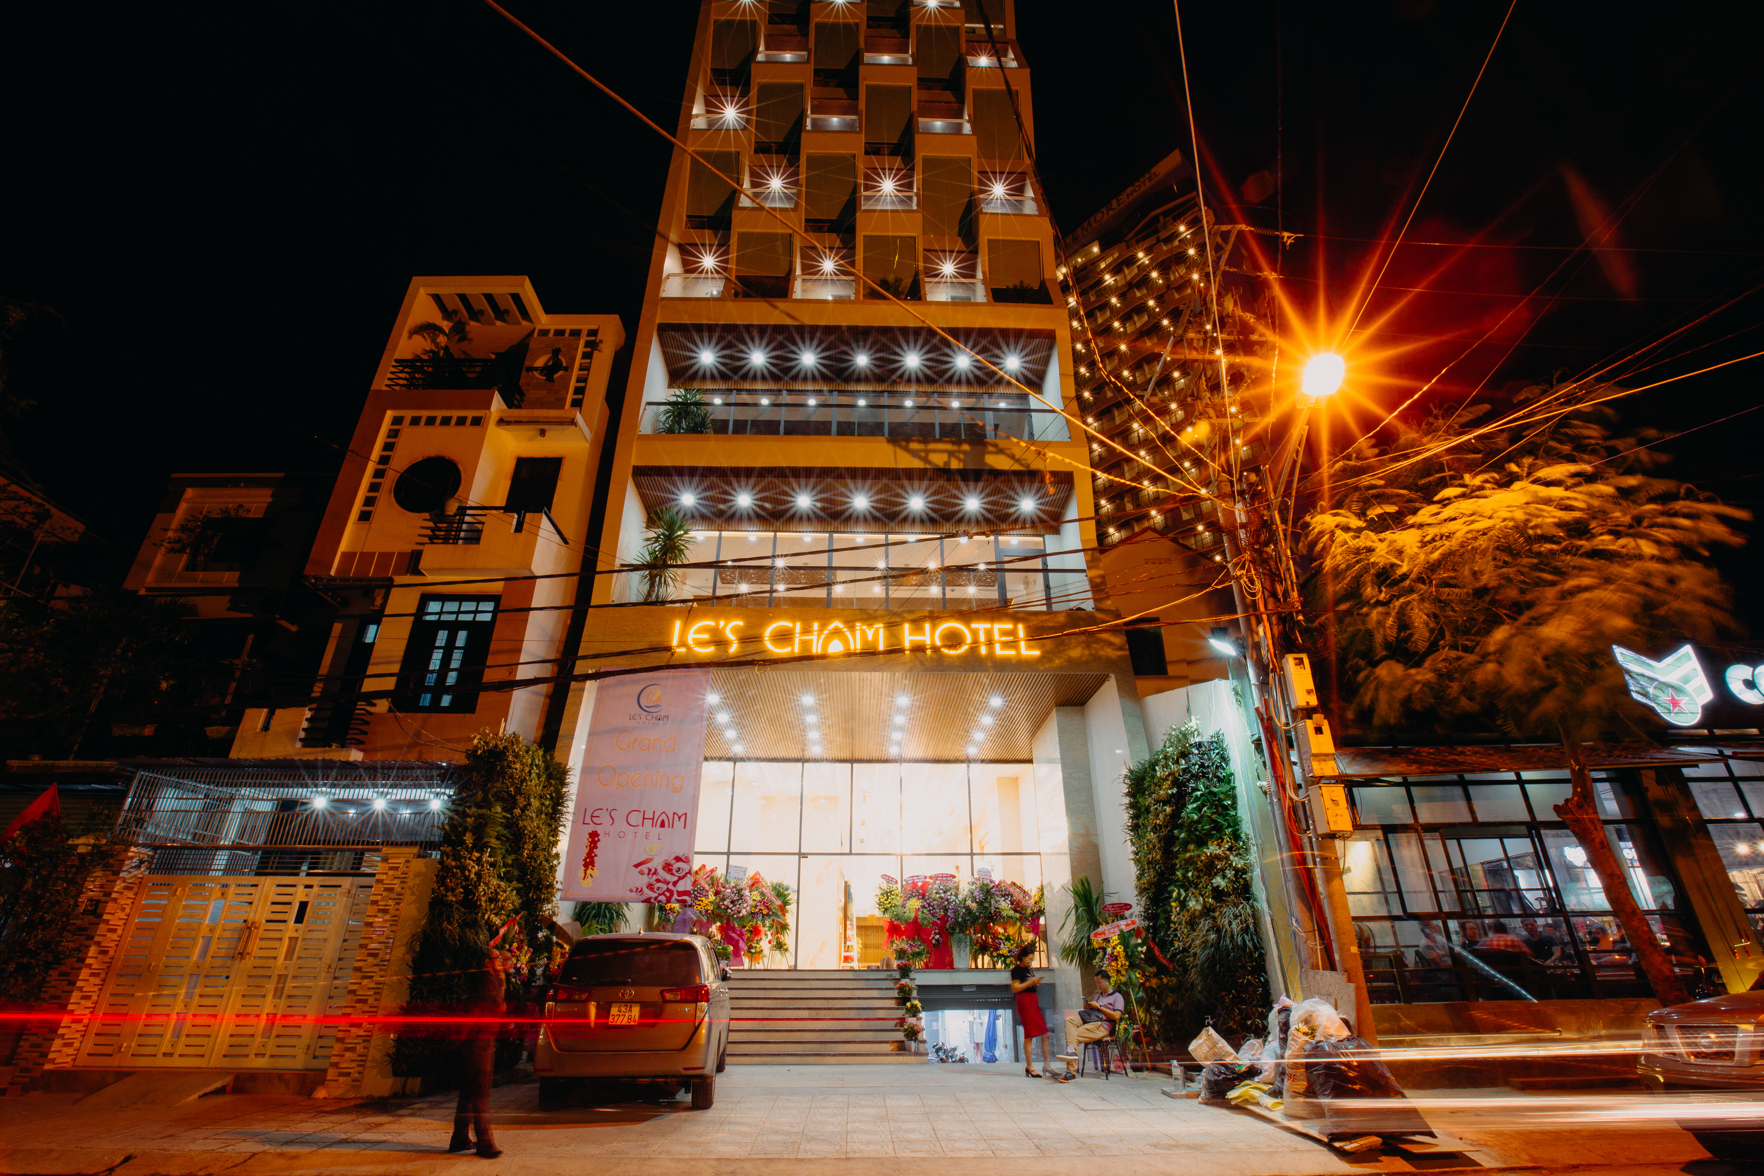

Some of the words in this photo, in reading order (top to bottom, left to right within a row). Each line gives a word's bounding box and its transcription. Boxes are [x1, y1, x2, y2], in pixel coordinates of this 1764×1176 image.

[1126, 171, 1160, 199] HOTEL
[671, 620, 744, 653] LE'S
[764, 621, 884, 653] CHAM
[904, 623, 1040, 655] HOTEL
[615, 729, 677, 753] Grand
[597, 764, 684, 794] Opening
[582, 807, 618, 827] LE'S
[625, 809, 688, 830] CHAM
[603, 830, 662, 841] HOTEL
[617, 1004, 633, 1014] 43A
